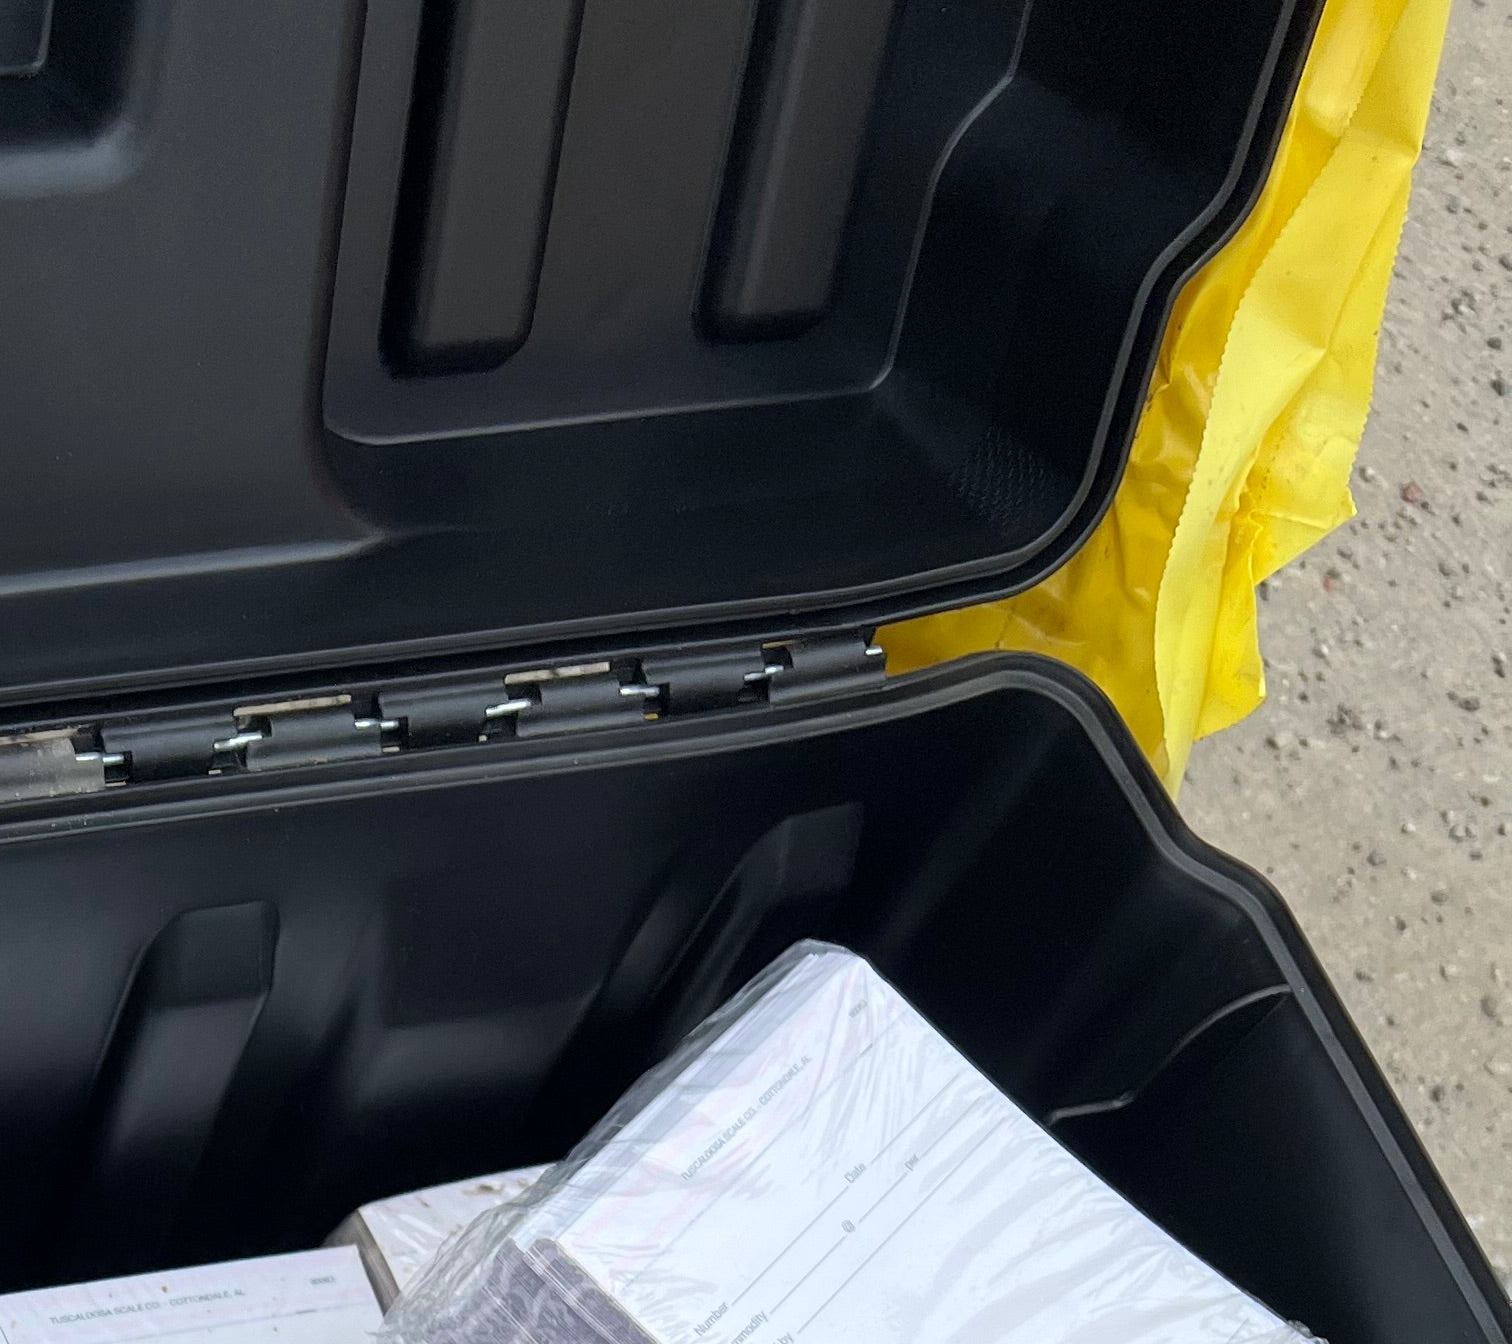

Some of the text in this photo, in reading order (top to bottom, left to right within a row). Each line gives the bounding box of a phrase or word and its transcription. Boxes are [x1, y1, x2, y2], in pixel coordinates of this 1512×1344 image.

[842, 1159, 869, 1185] Date
[902, 1152, 923, 1172] per
[692, 1299, 729, 1337] Number
